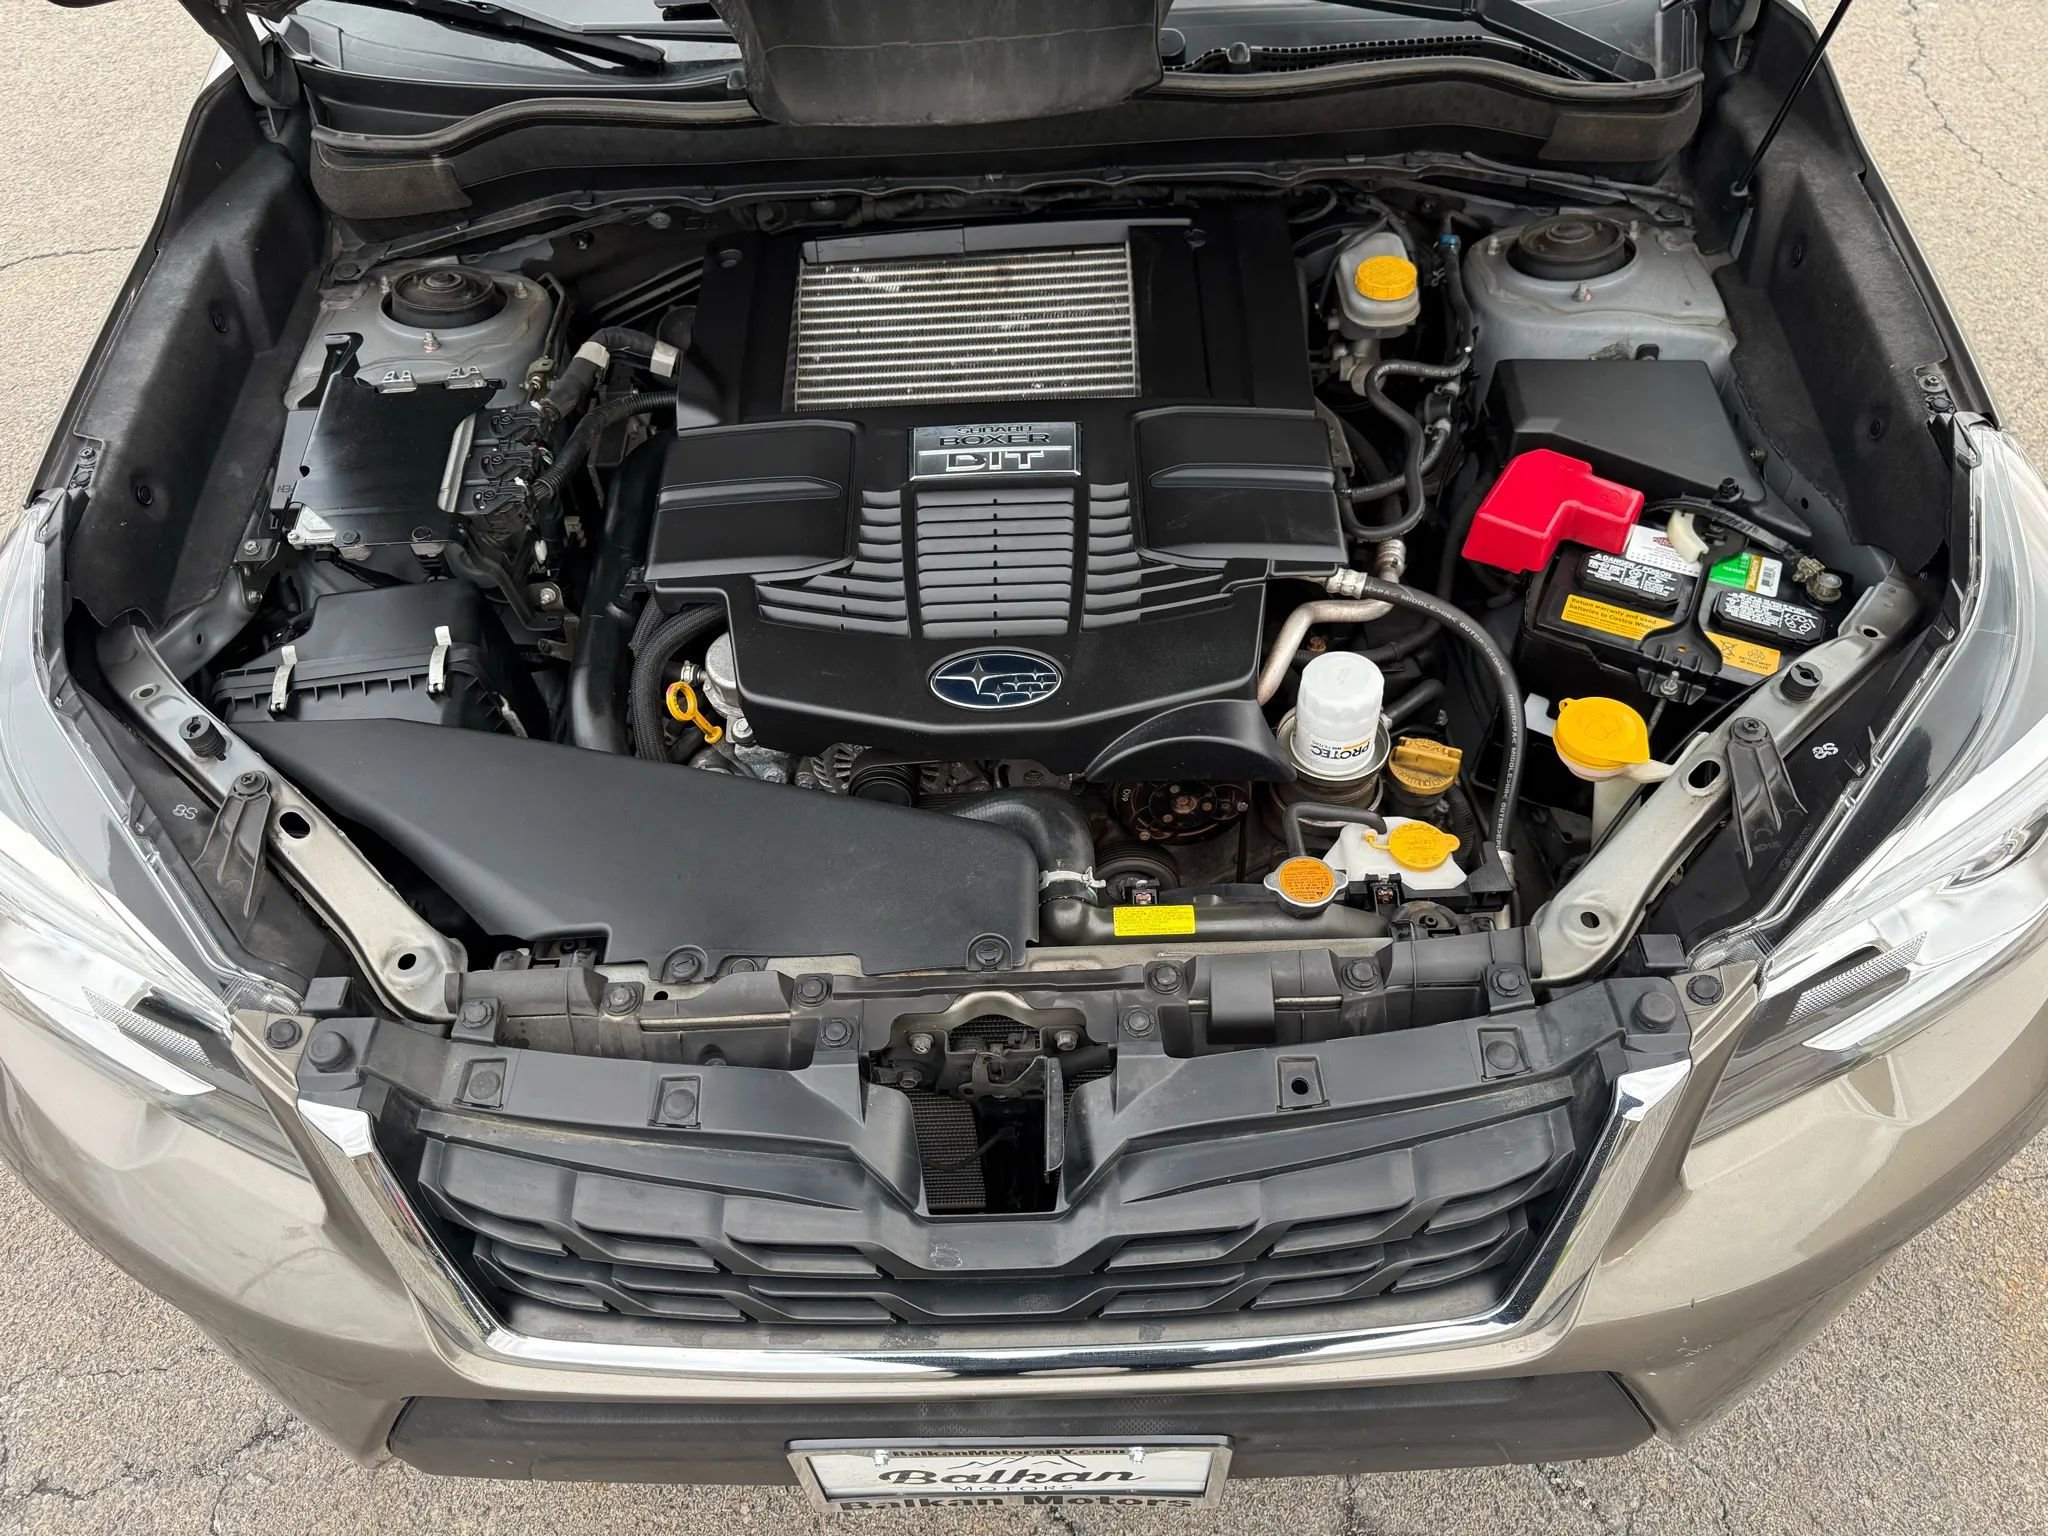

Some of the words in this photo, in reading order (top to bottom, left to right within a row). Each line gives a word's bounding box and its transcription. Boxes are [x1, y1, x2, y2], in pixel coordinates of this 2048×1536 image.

[939, 433, 1050, 446] BOXER
[957, 425, 1032, 435] SUBARU
[946, 450, 1045, 472] DIT
[1603, 555, 1636, 569] DANGER
[1642, 566, 1672, 579] POISON
[1569, 603, 1599, 616] batteries
[1609, 614, 1633, 625] Costco
[1571, 597, 1594, 608] Return
[1595, 605, 1625, 617] warranty
[1626, 612, 1639, 621] and
[1639, 616, 1657, 625] used
[1310, 741, 1370, 760] PROTEC
[879, 1469, 1146, 1485] Balkan
[840, 1498, 1004, 1511] Balkan
[1023, 1495, 1192, 1507] Motors
